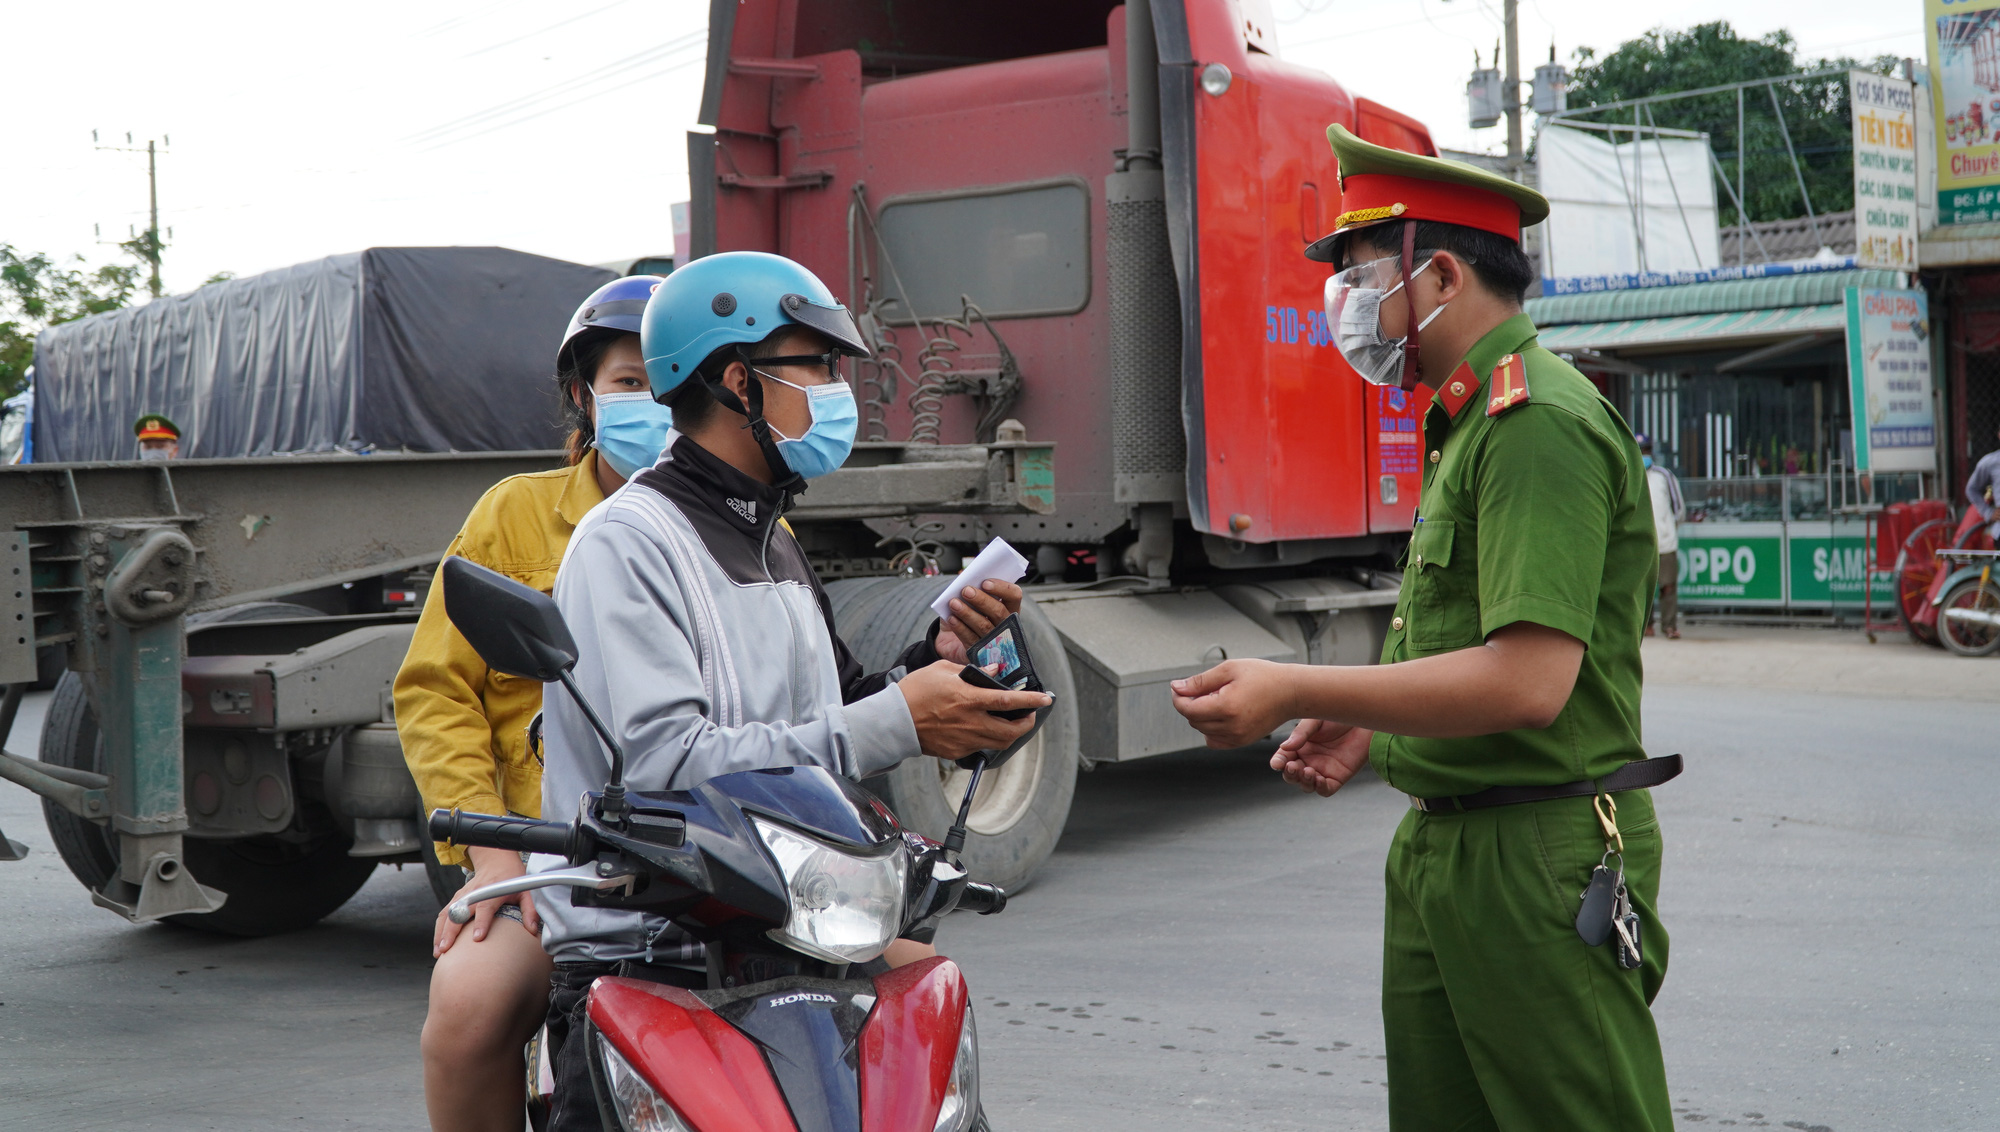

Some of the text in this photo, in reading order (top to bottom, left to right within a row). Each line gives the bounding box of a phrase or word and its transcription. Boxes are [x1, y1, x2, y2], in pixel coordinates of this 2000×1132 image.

[1887, 86, 1911, 110] PCCC
[1266, 305, 1337, 348] 51D-38
[726, 497, 758, 524] adidas
[769, 993, 838, 1008] HONDA
